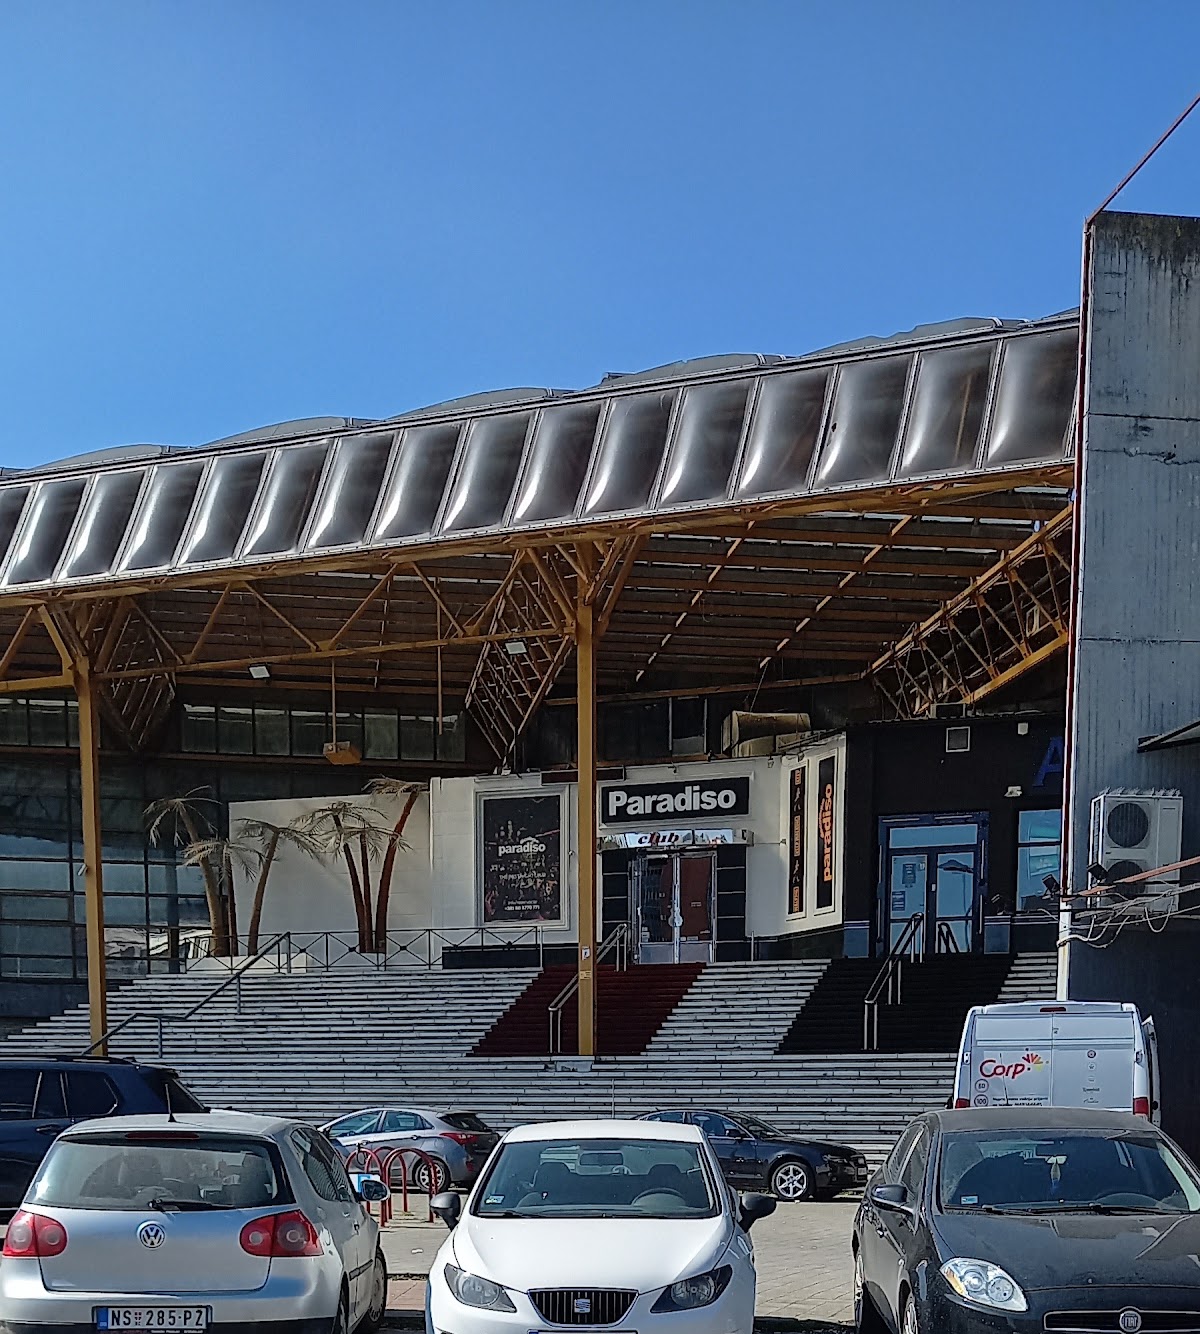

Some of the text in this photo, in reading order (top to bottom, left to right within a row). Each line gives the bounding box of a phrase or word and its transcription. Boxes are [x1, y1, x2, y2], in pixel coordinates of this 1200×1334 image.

[608, 785, 737, 816] Paradiso
[822, 783, 832, 882] paradiso
[498, 841, 546, 856] paradiso
[980, 1059, 1026, 1079] Corp
[111, 1310, 132, 1326] NS
